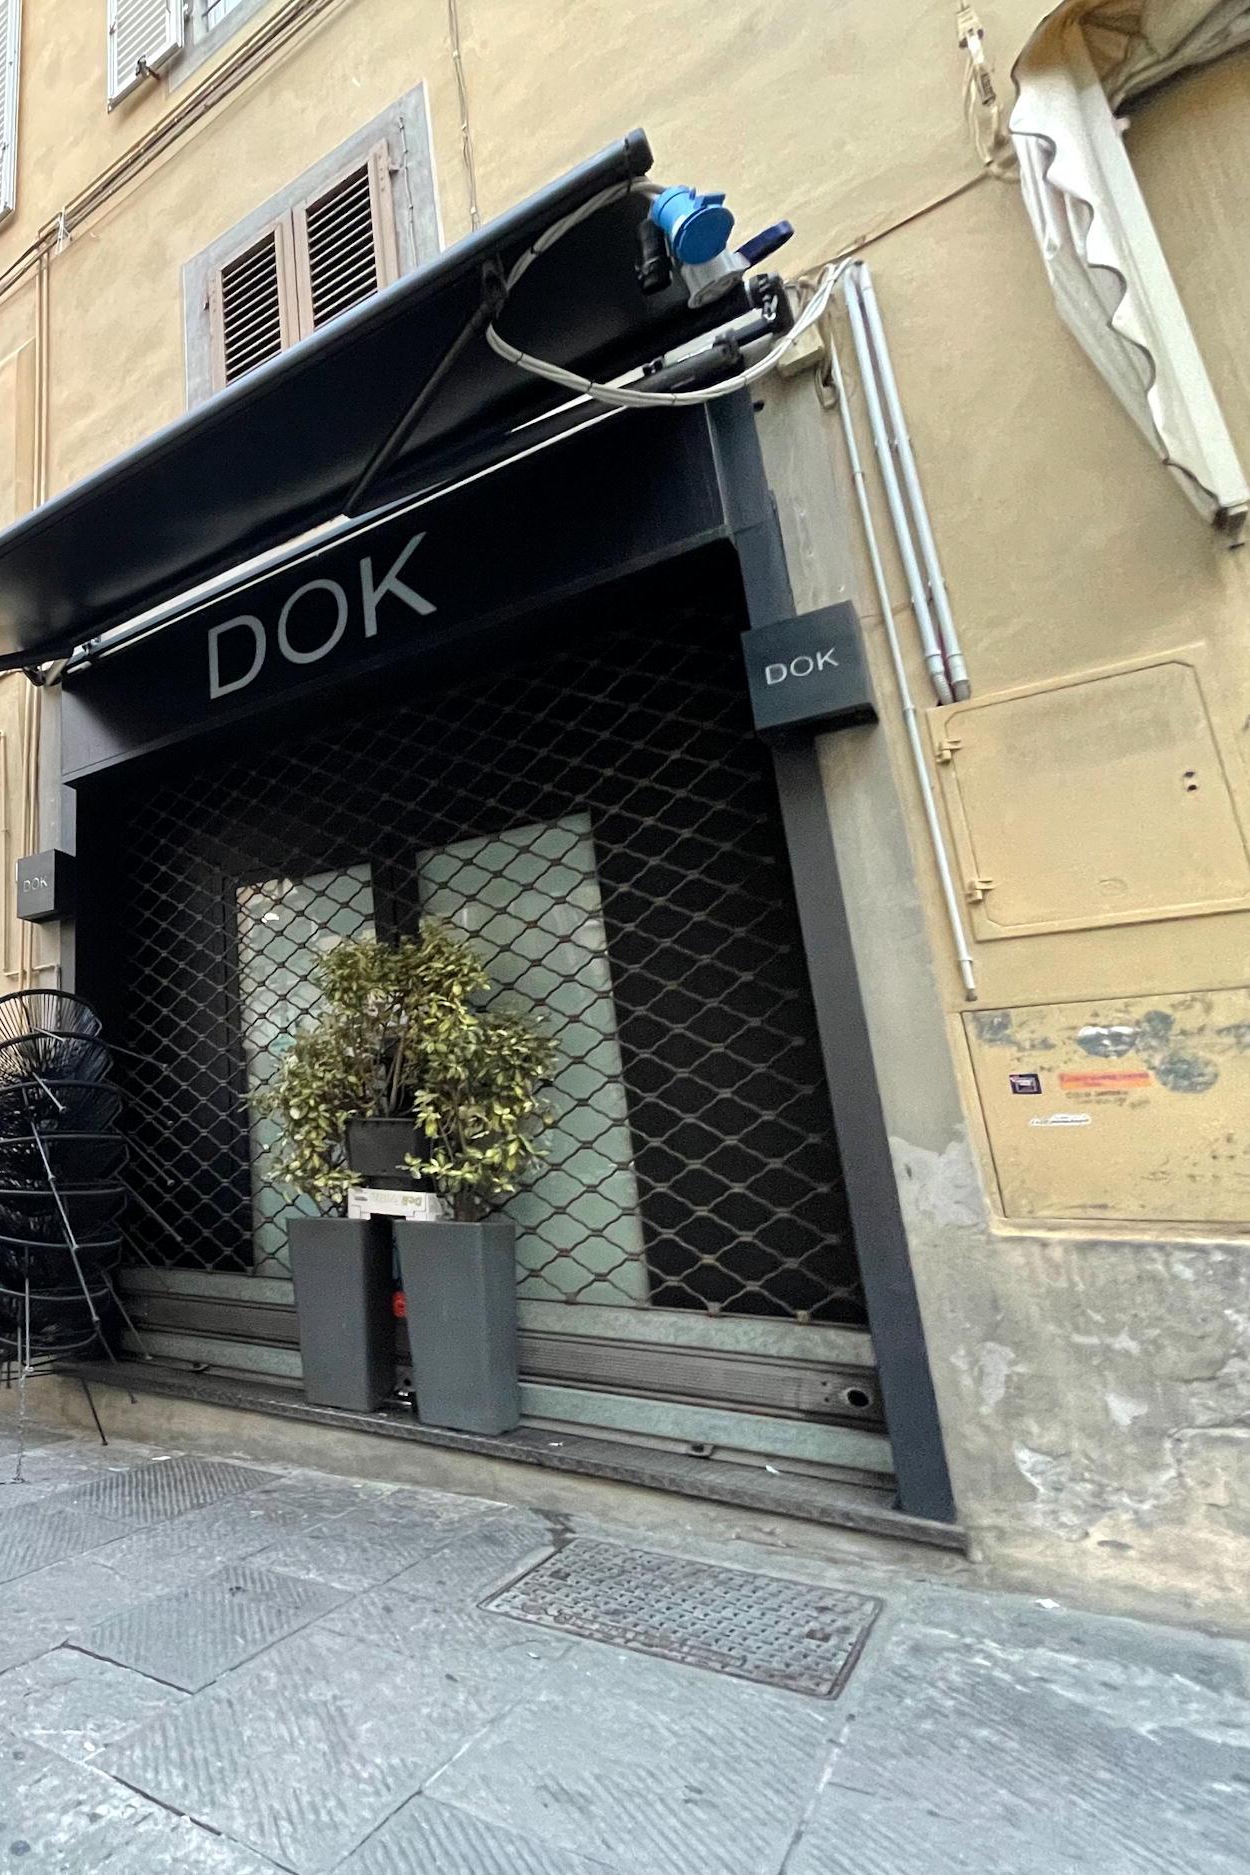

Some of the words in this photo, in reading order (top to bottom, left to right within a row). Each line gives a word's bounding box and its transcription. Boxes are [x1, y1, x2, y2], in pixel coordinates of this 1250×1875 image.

[208, 531, 437, 700] DOK
[765, 647, 839, 685] DOK
[23, 875, 48, 893] DOK
